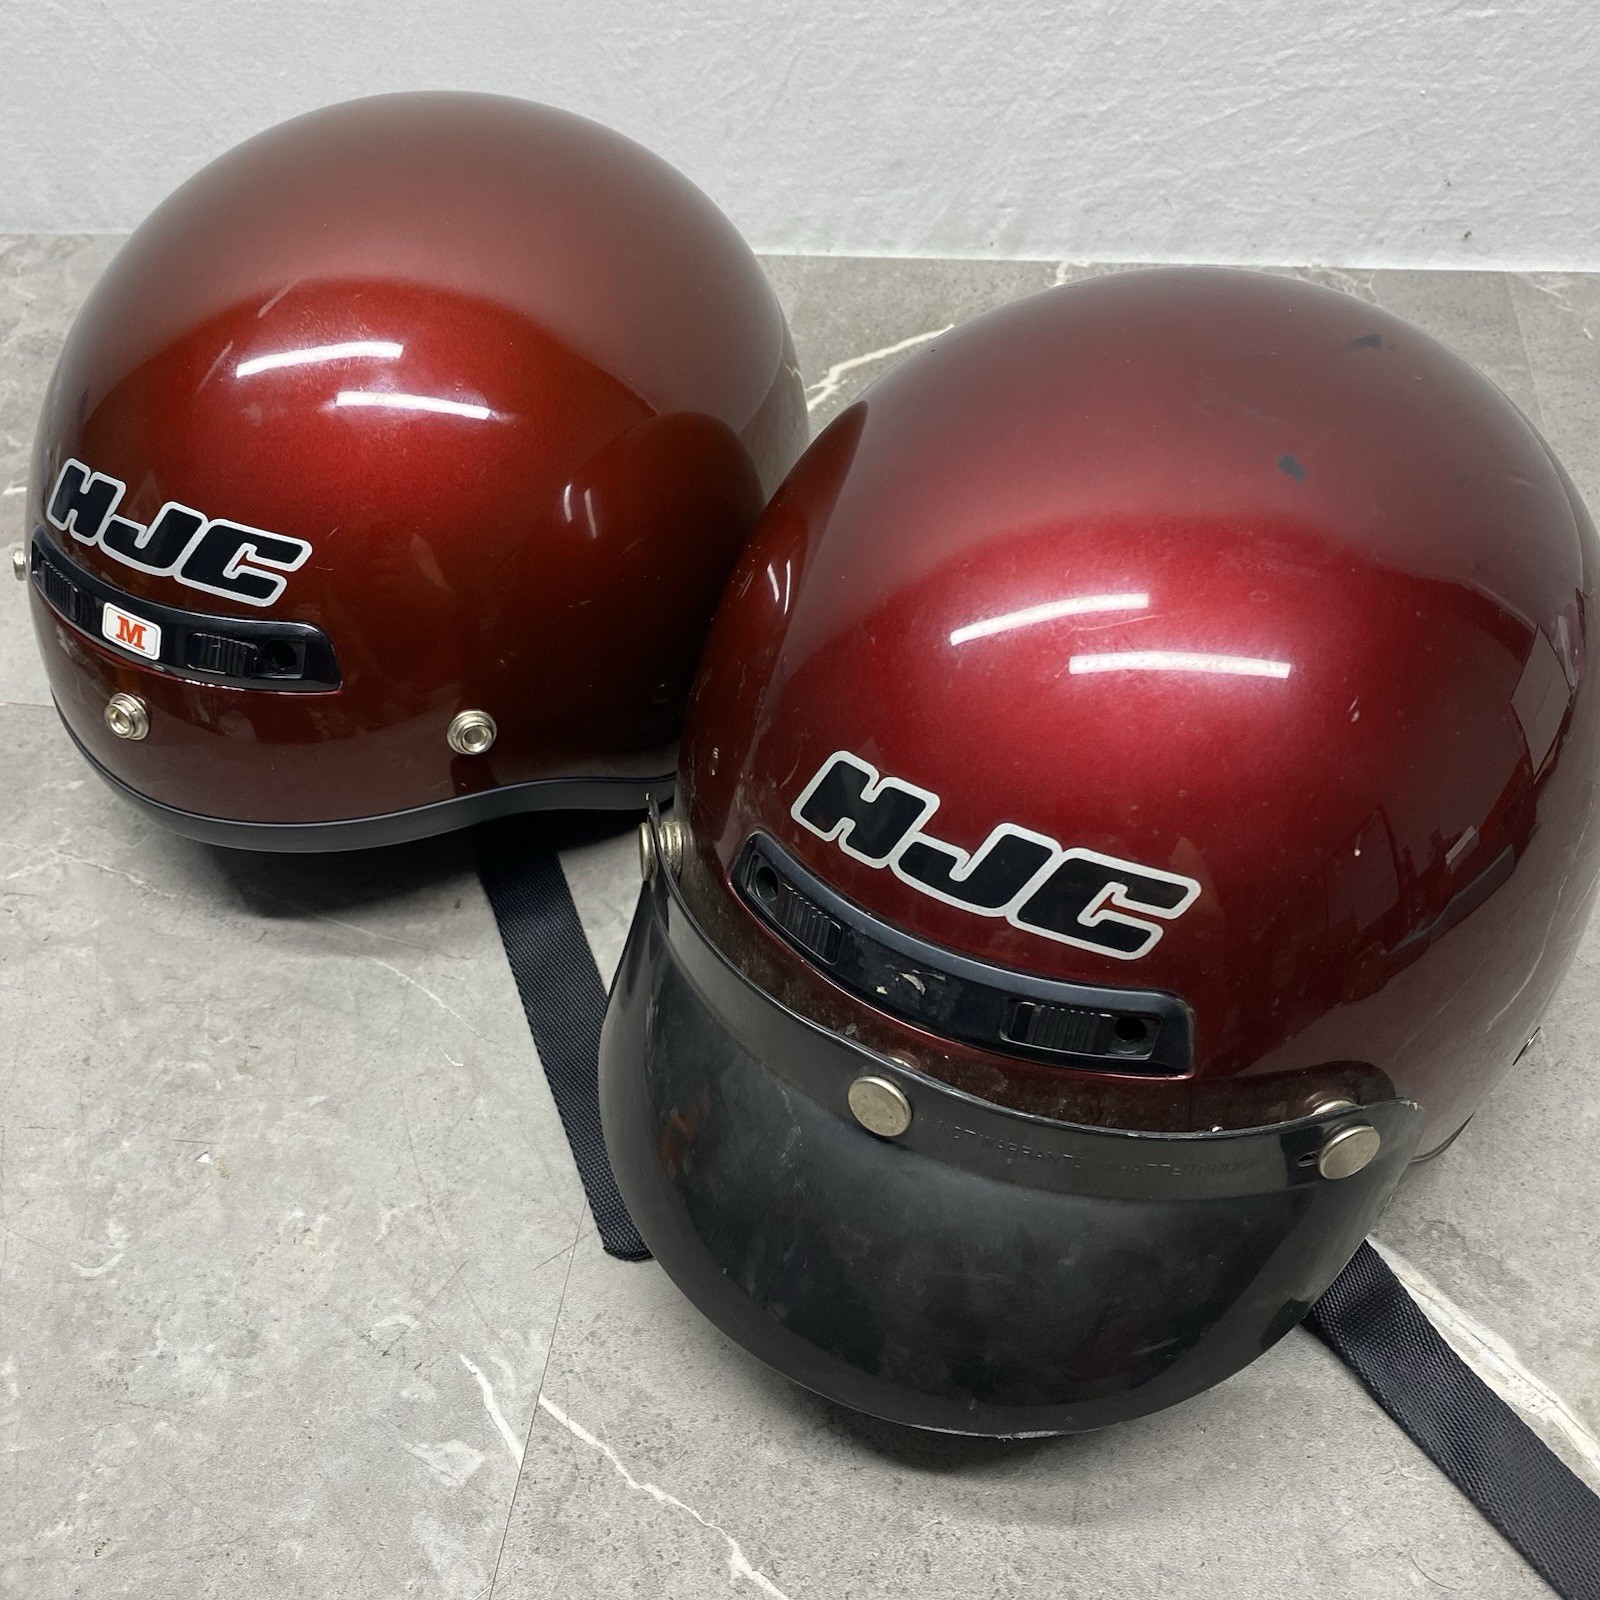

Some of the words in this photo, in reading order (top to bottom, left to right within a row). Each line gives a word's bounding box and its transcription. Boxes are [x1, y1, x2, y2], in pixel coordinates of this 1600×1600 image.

[47, 457, 313, 607] HJC
[115, 615, 147, 650] M
[791, 750, 1202, 960] HJC
